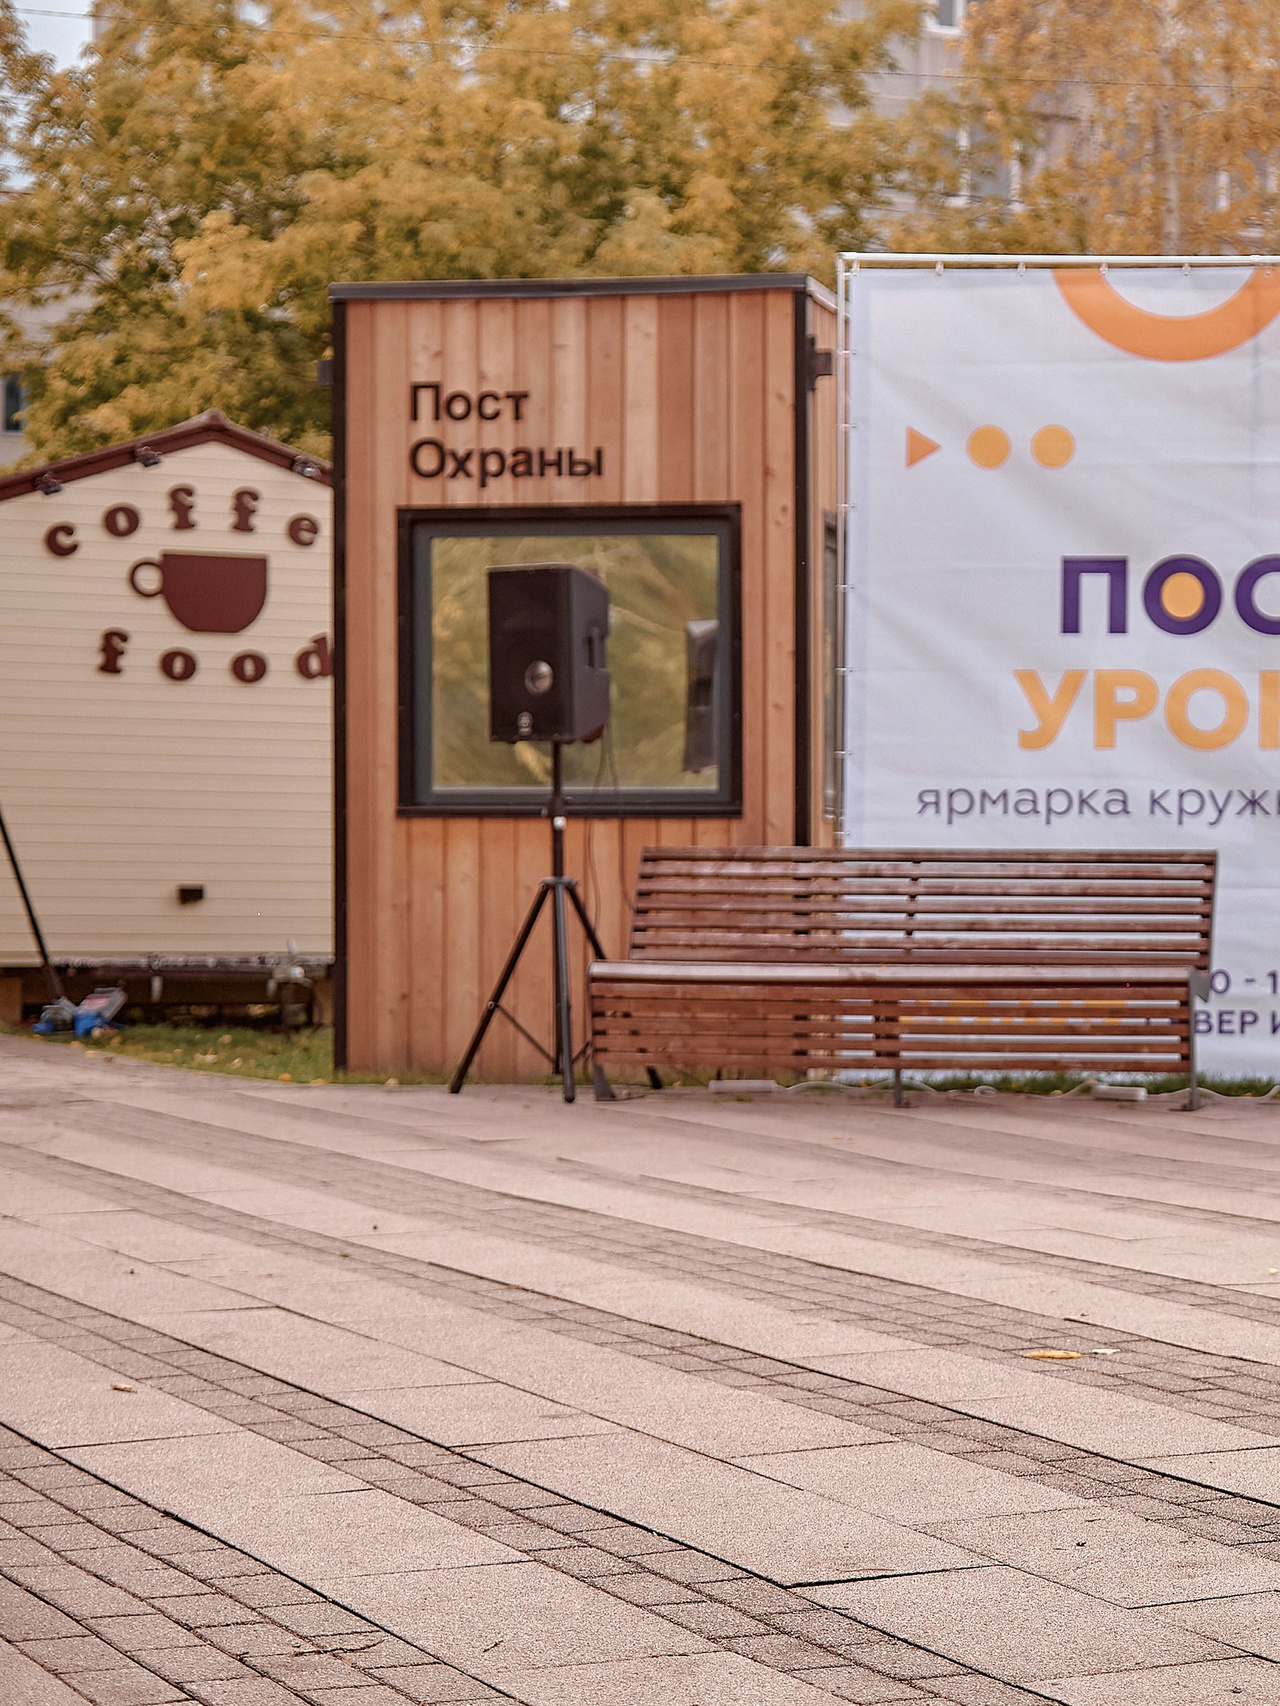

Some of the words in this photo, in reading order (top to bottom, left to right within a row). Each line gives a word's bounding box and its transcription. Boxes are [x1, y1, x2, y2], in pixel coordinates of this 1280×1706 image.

[410, 383, 530, 421] Пост
[410, 438, 604, 487] Охраны
[45, 484, 319, 557] coffe
[99, 628, 334, 682] food
[916, 787, 1131, 825] ярмарка
[1209, 969, 1231, 995] 0
[1195, 1011, 1259, 1035] ВЕР
